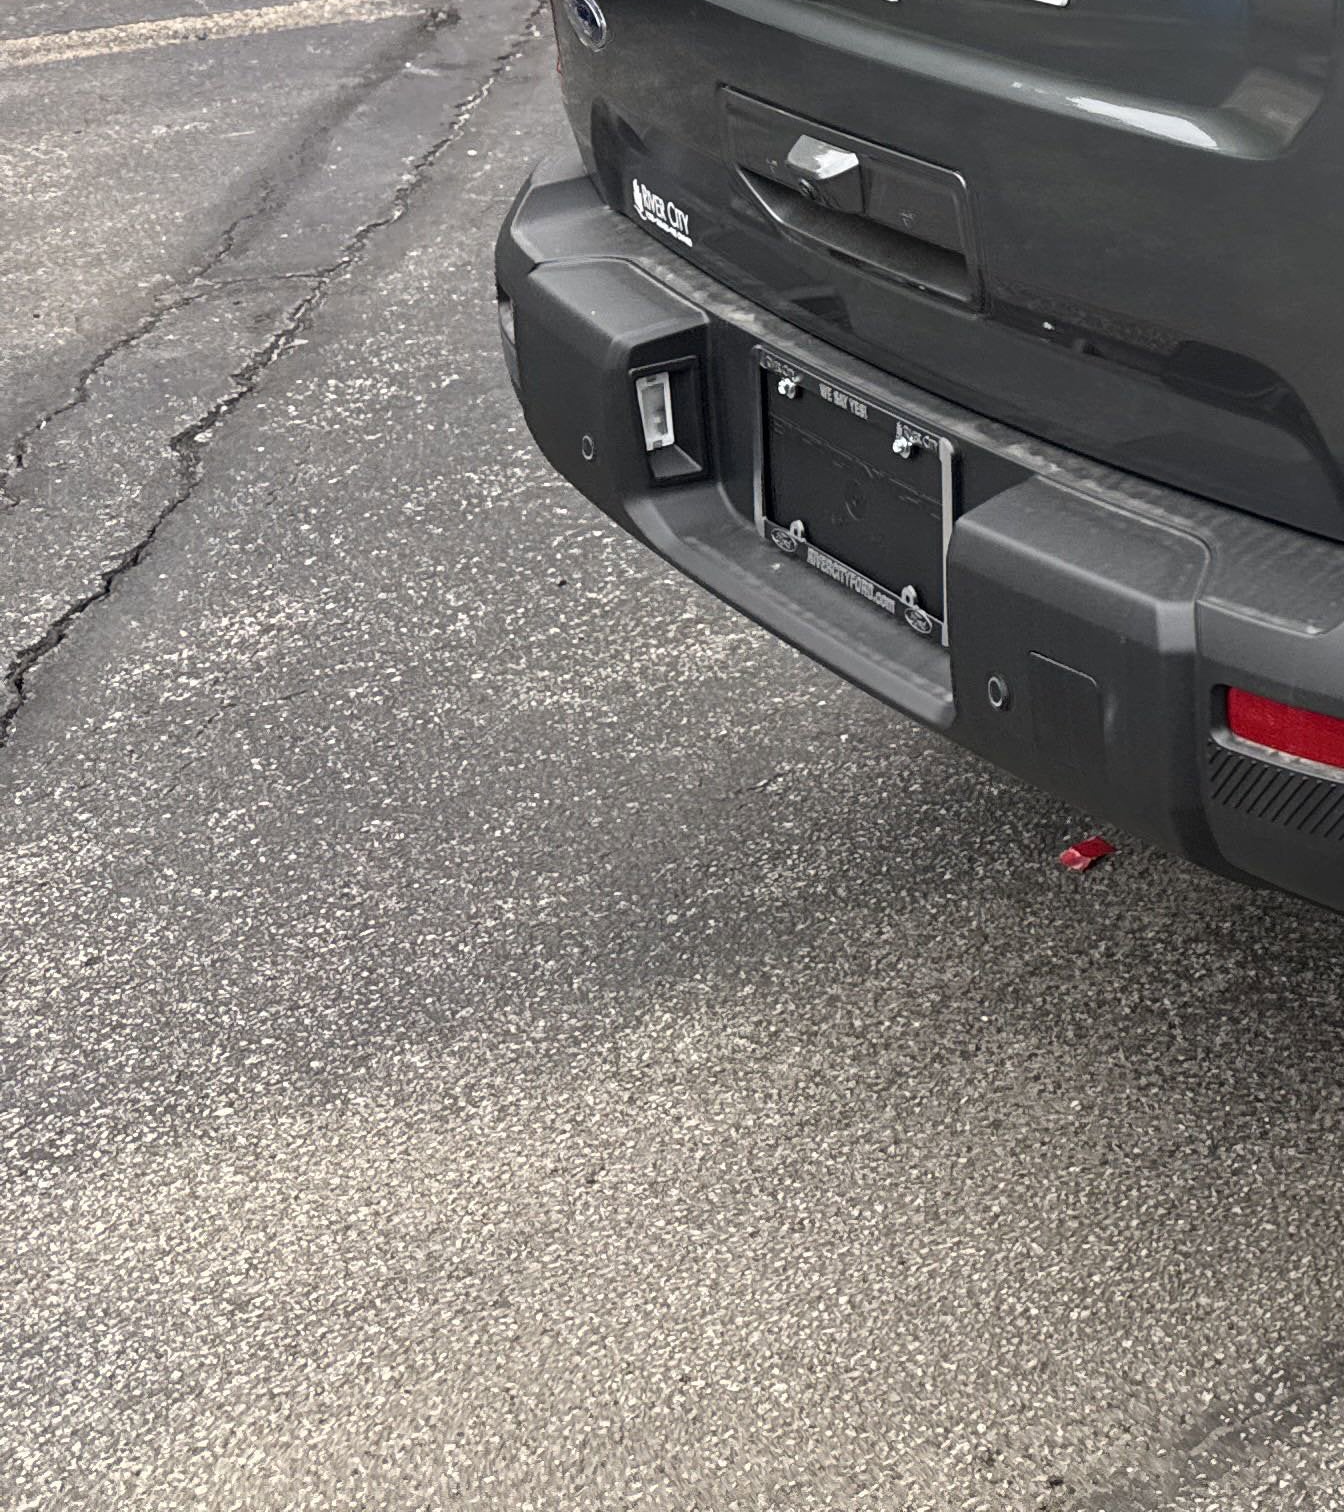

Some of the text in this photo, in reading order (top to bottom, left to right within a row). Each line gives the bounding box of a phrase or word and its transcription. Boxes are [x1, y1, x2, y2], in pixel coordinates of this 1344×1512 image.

[641, 183, 667, 221] RIVER
[667, 201, 689, 236] CITY
[818, 383, 833, 403] WE
